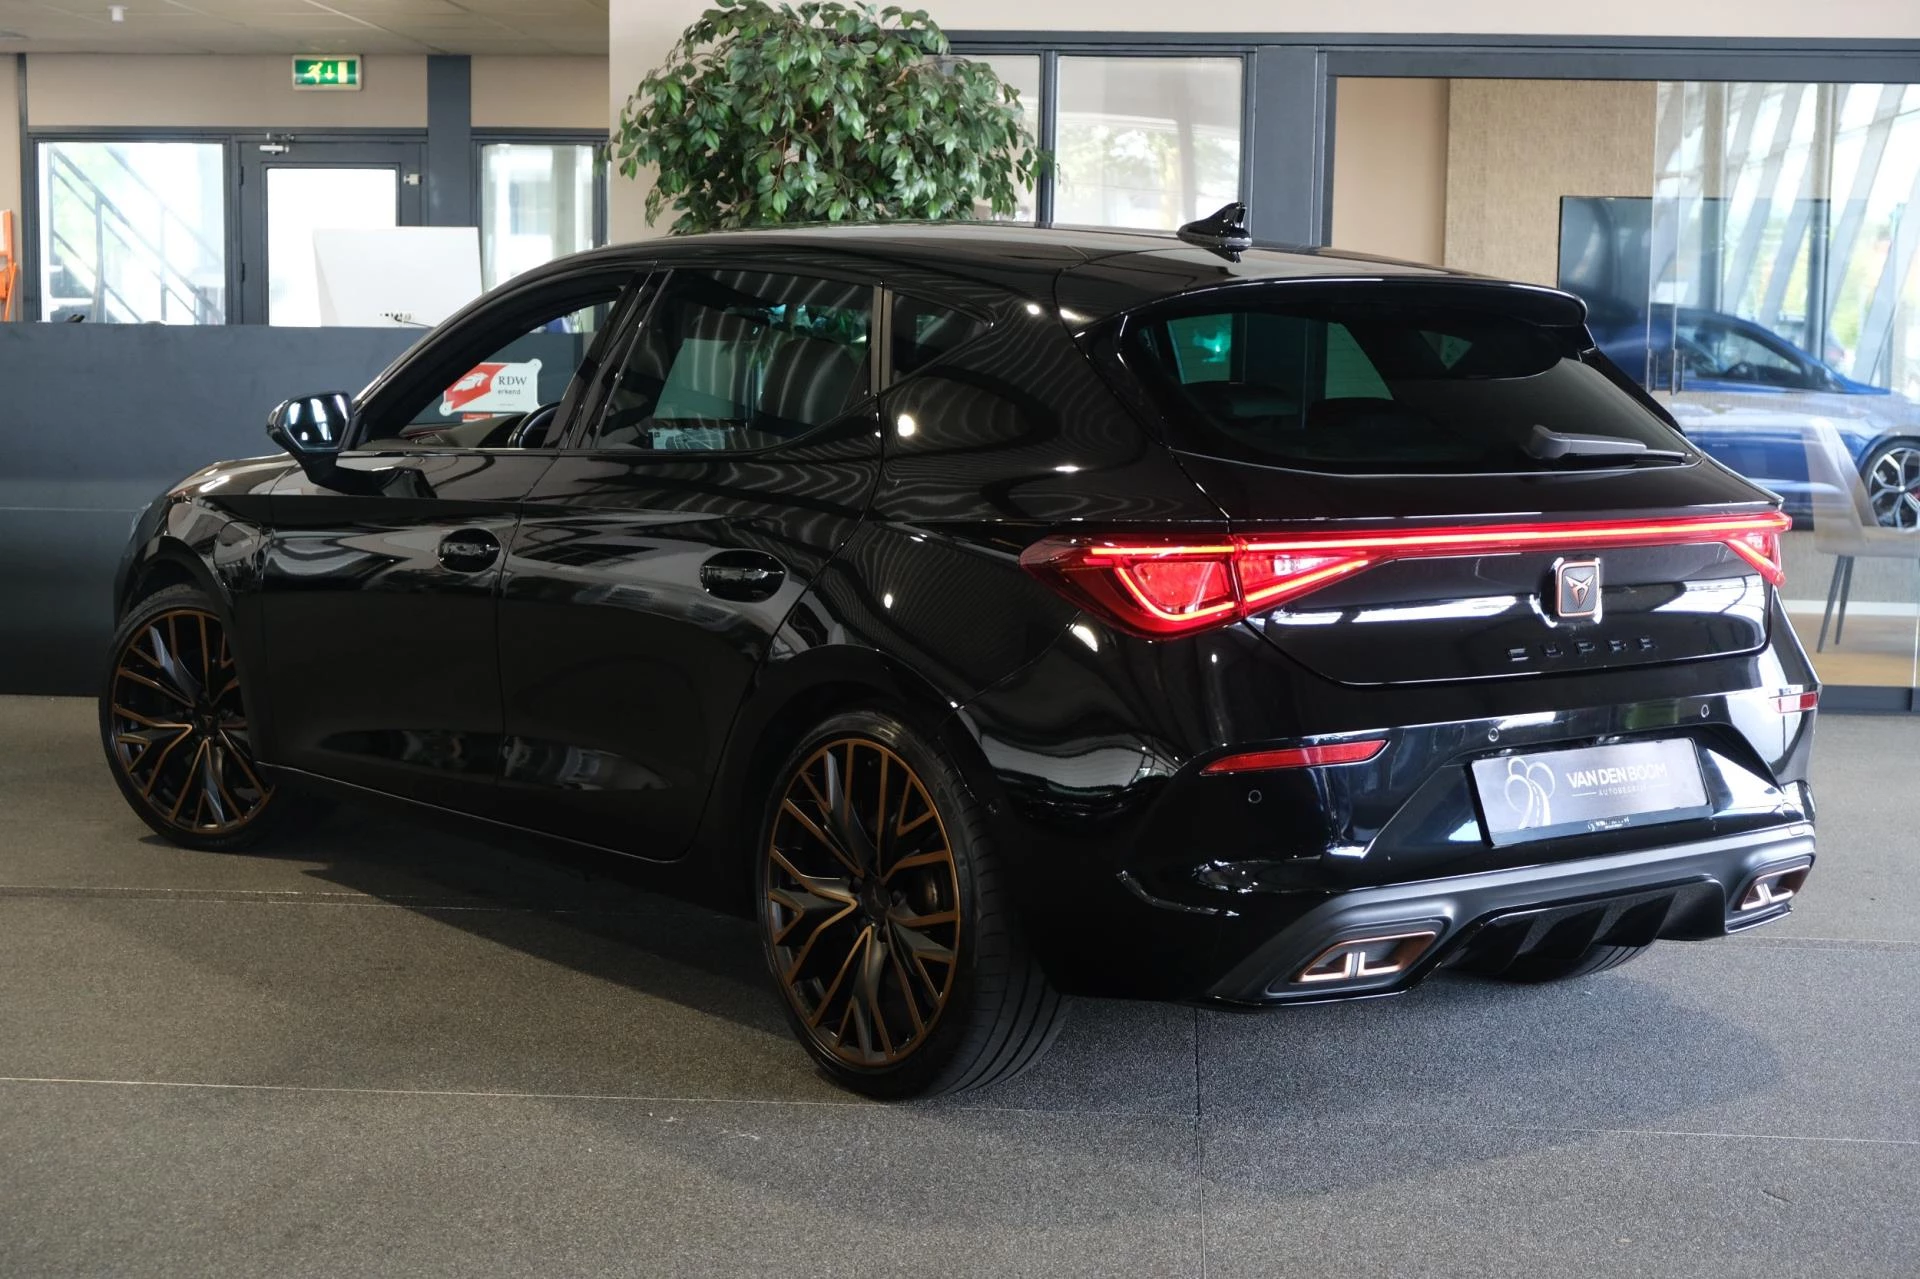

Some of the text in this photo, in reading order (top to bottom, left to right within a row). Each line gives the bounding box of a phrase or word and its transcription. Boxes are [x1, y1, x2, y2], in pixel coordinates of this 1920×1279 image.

[499, 376, 527, 385] RDW
[1508, 638, 1659, 662] CUPRA
[1566, 763, 1668, 789] VAN DEN BOOM
